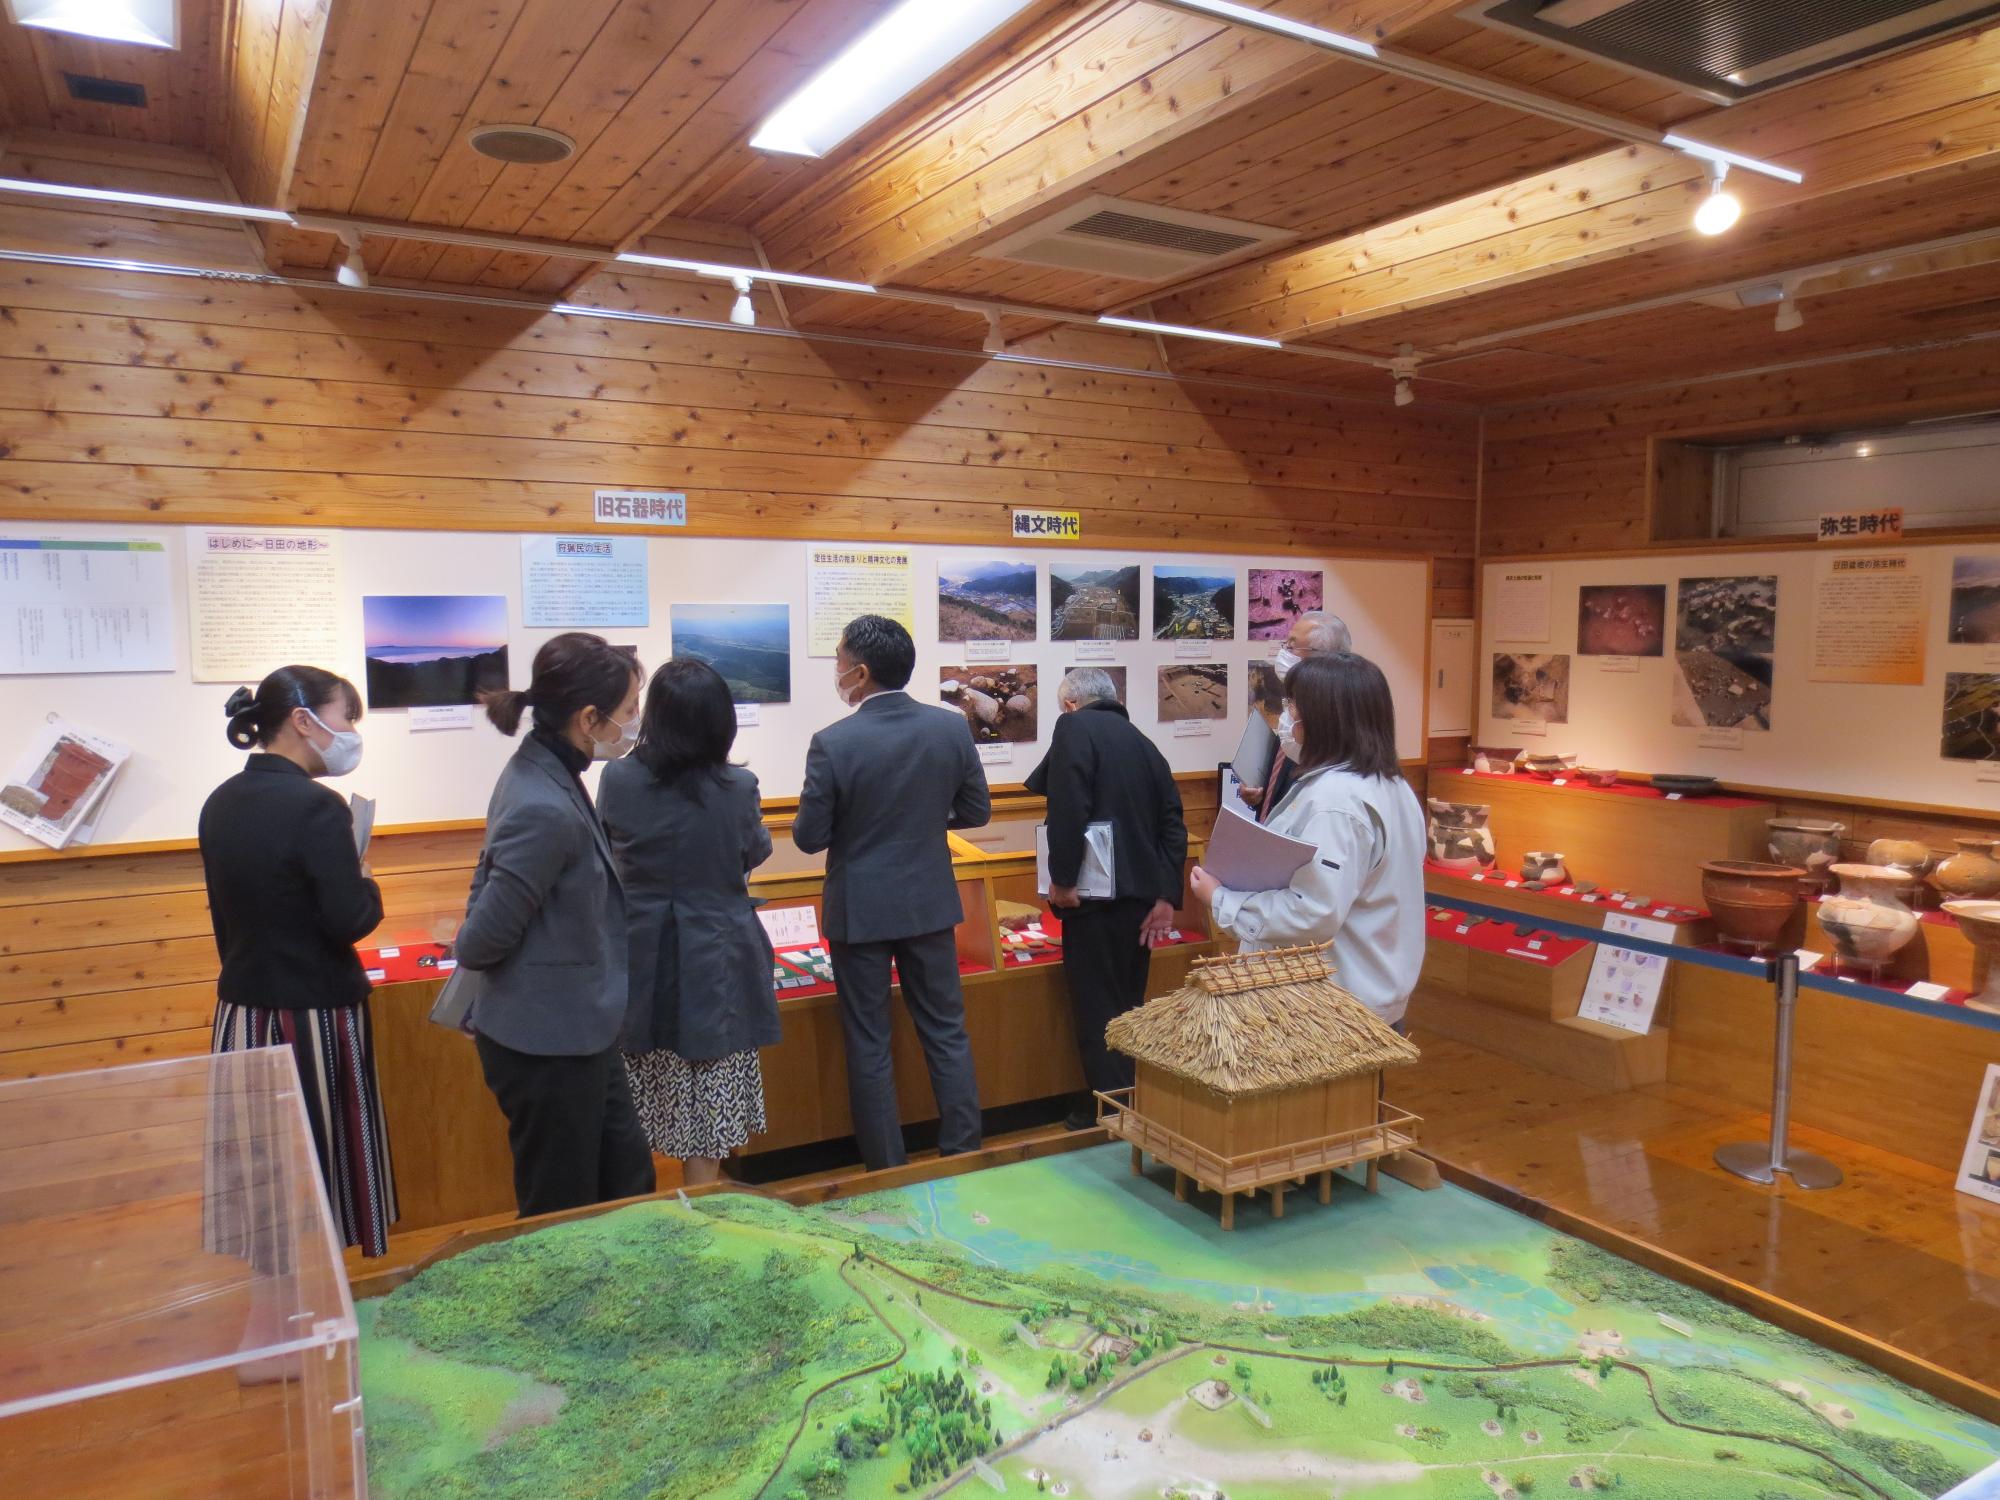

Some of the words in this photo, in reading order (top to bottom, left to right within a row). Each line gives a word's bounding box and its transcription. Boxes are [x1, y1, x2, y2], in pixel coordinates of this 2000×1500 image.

[598, 496, 683, 519] 旧石器時代
[1015, 514, 1078, 535] 縄文時代
[1820, 513, 1900, 536] 弥生時代
